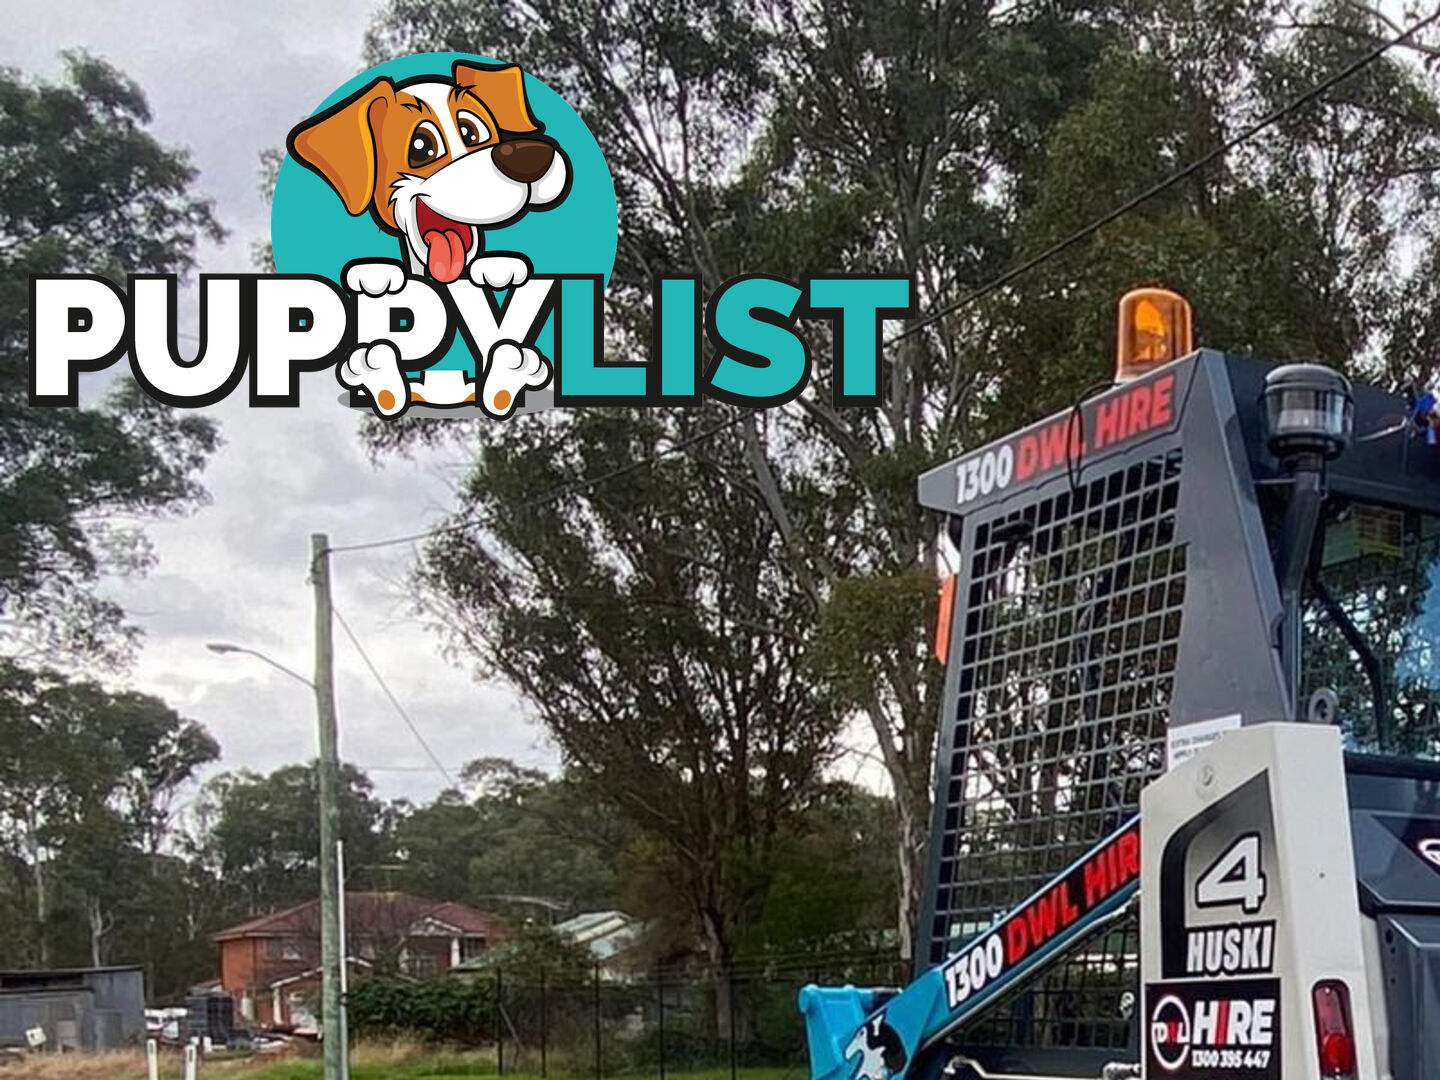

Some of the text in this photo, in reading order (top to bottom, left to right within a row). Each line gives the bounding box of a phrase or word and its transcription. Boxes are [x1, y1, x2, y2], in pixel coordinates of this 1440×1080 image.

[956, 374, 1175, 504] 1300 DWL HIRE
[1196, 834, 1265, 911] 4
[945, 829, 1140, 1009] 1300 DWL HIR
[1185, 925, 1274, 974] HUSKI
[1152, 999, 1276, 1045] DWL HIRE
[1191, 1049, 1271, 1069] 1300 395 447
